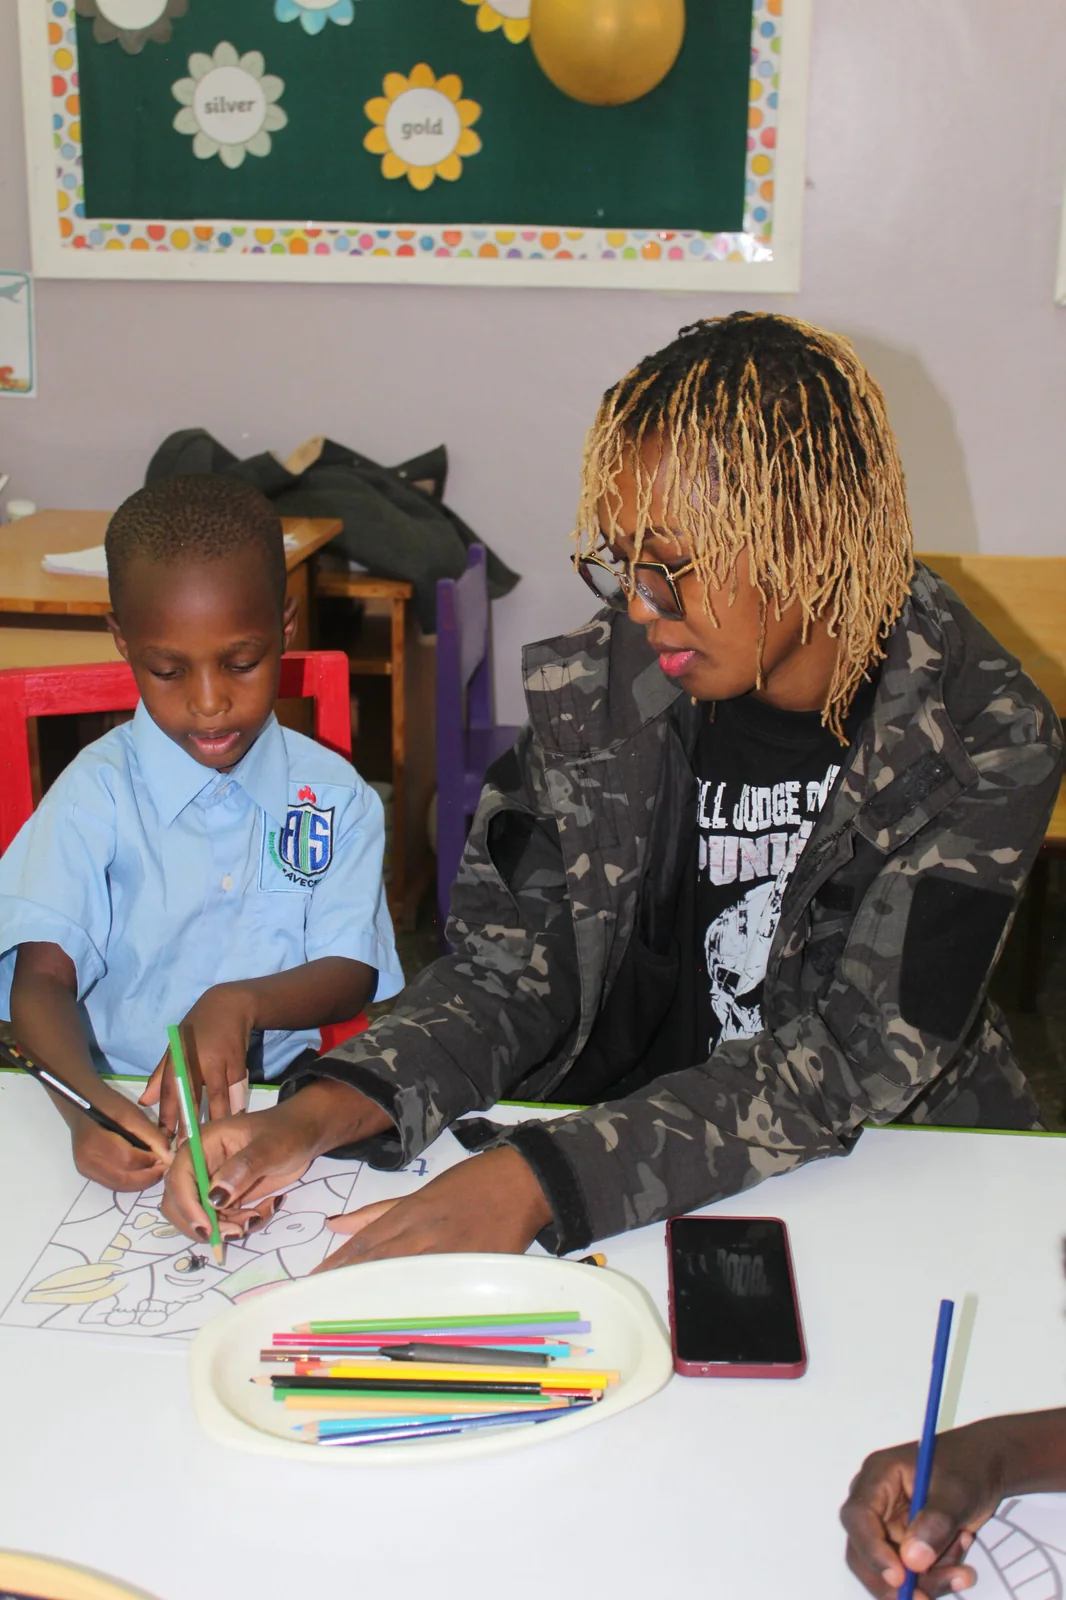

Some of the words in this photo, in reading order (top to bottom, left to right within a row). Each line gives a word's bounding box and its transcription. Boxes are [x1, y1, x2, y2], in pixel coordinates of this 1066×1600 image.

[204, 96, 257, 114] silver
[401, 117, 443, 140] gold
[733, 781, 801, 832] JUDGE
